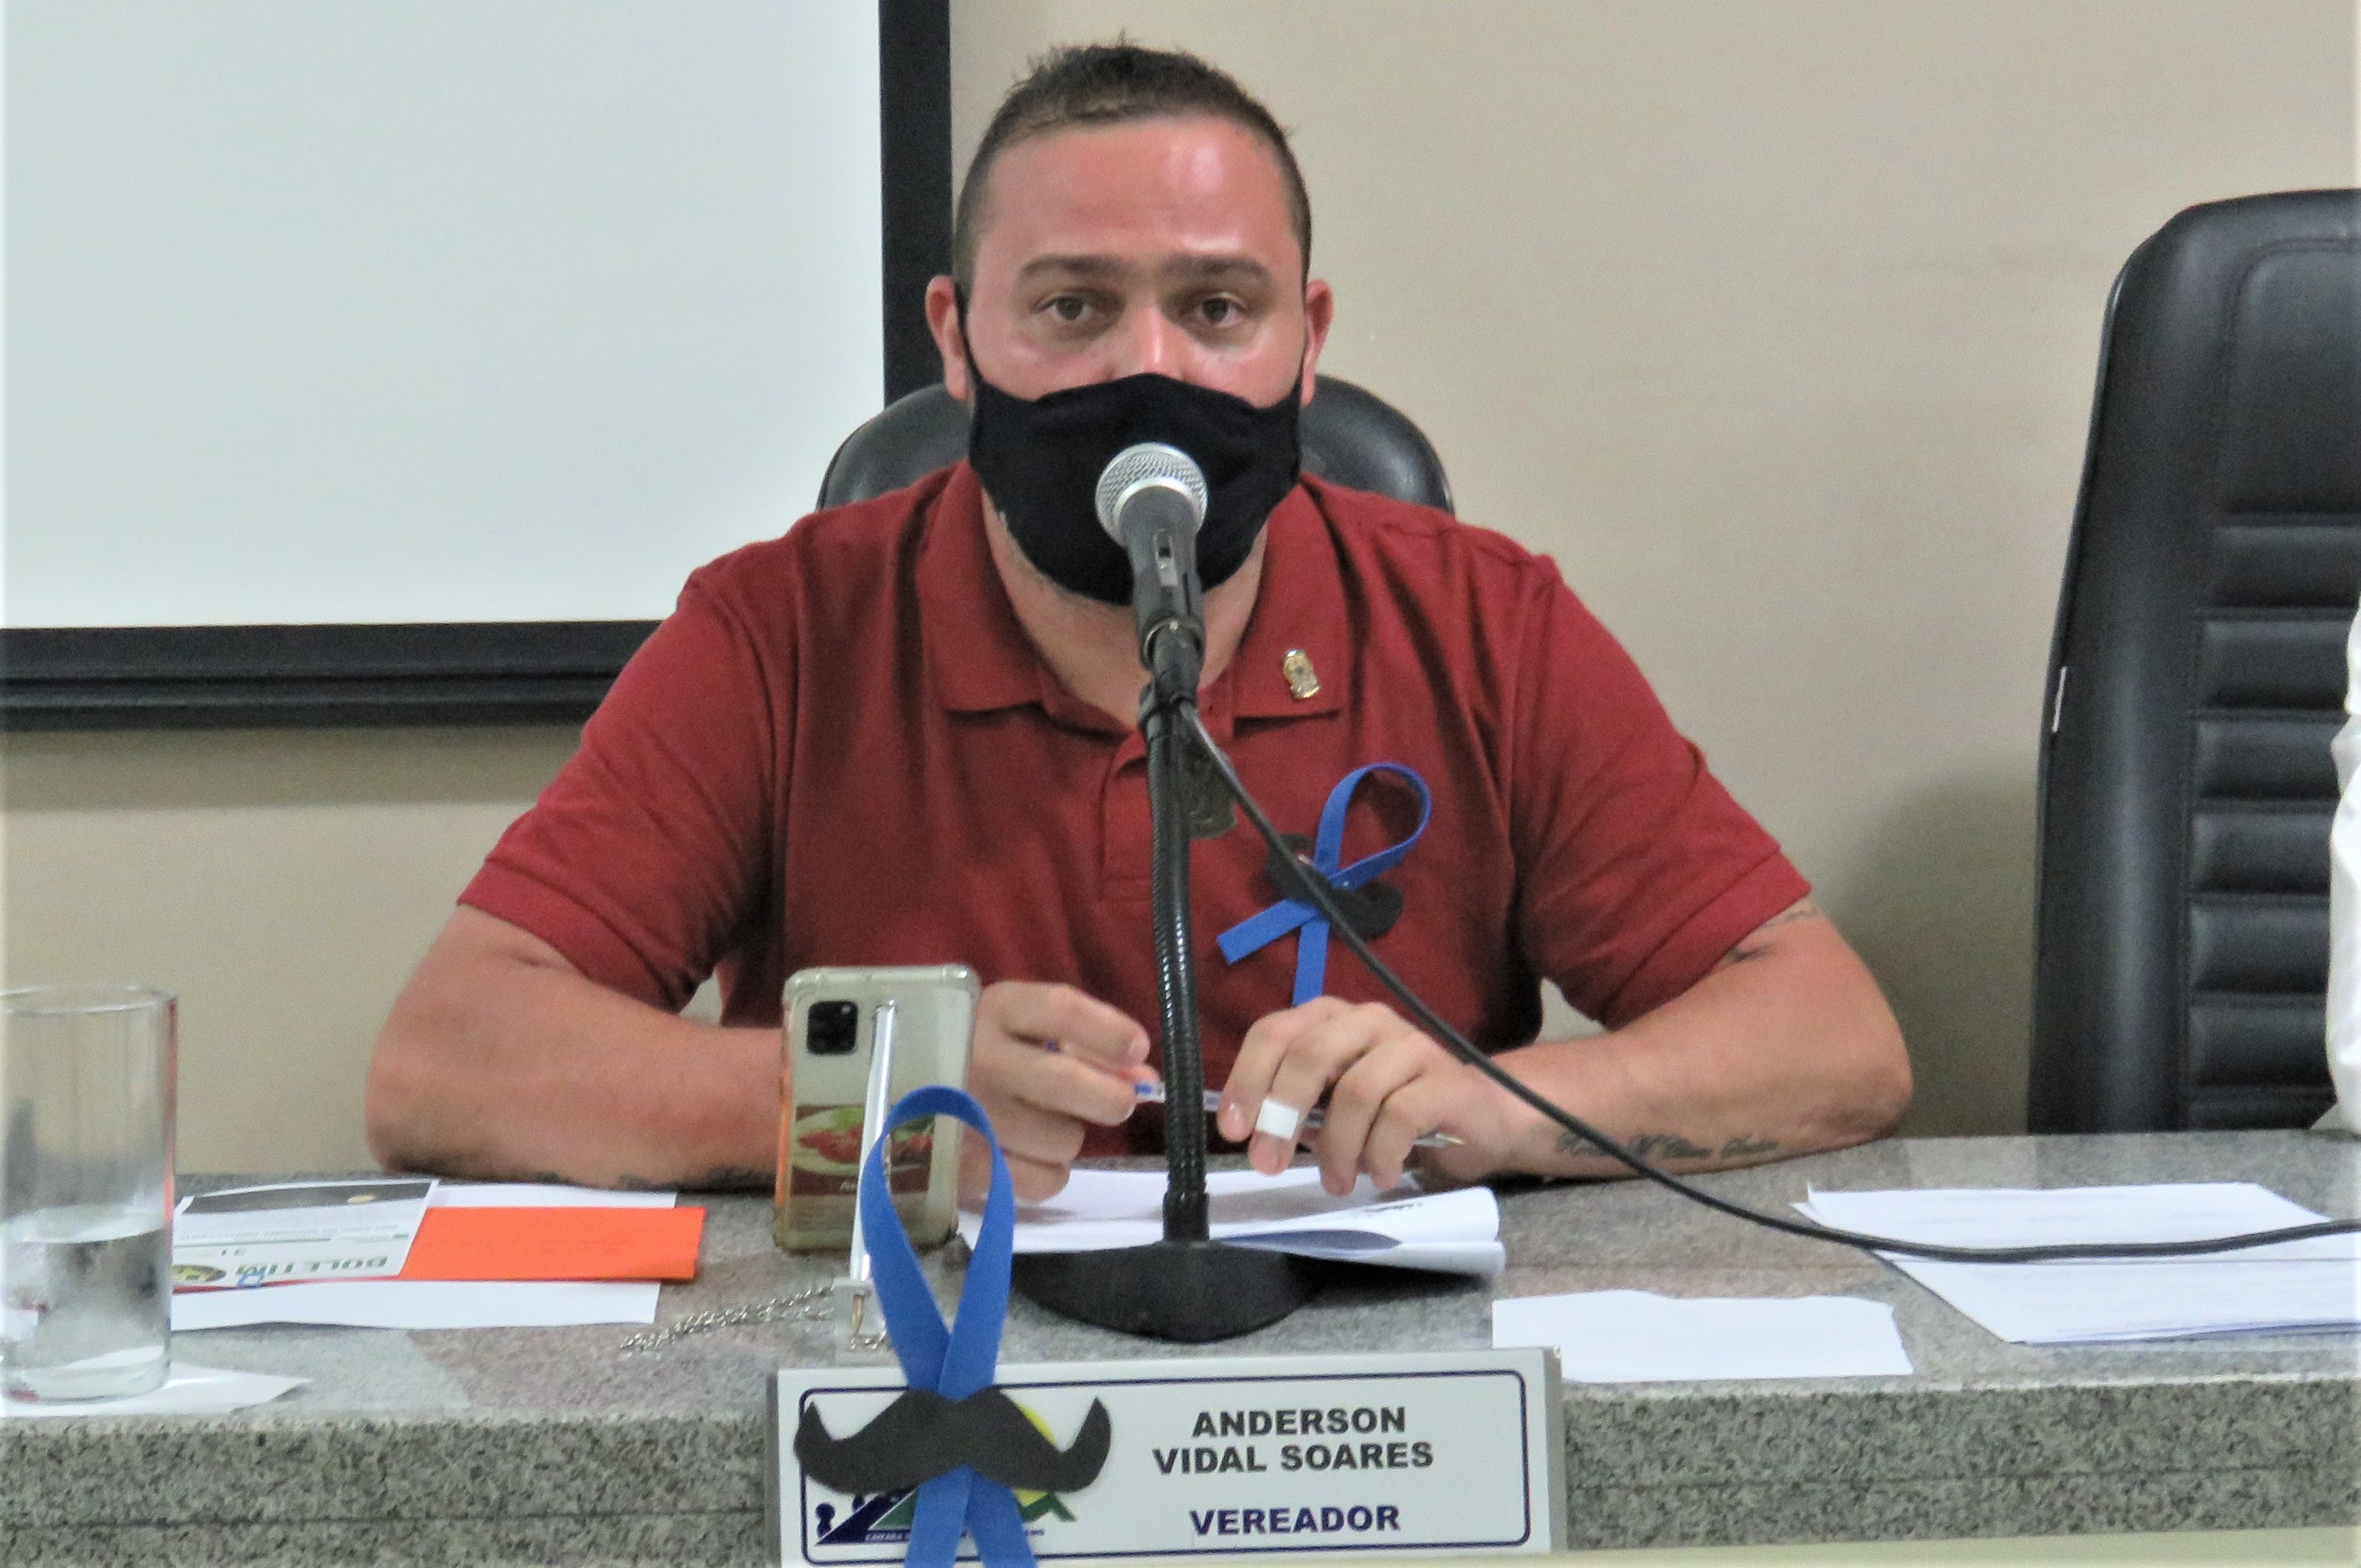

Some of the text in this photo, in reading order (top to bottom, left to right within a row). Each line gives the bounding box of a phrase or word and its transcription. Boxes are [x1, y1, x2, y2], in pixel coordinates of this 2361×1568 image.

[235, 1255, 388, 1277] BOLETIM
[1191, 1406, 1406, 1439] ANDERSON
[1152, 1442, 1434, 1475] VIDAL SOARES
[1189, 1505, 1401, 1536] VEREADOR
